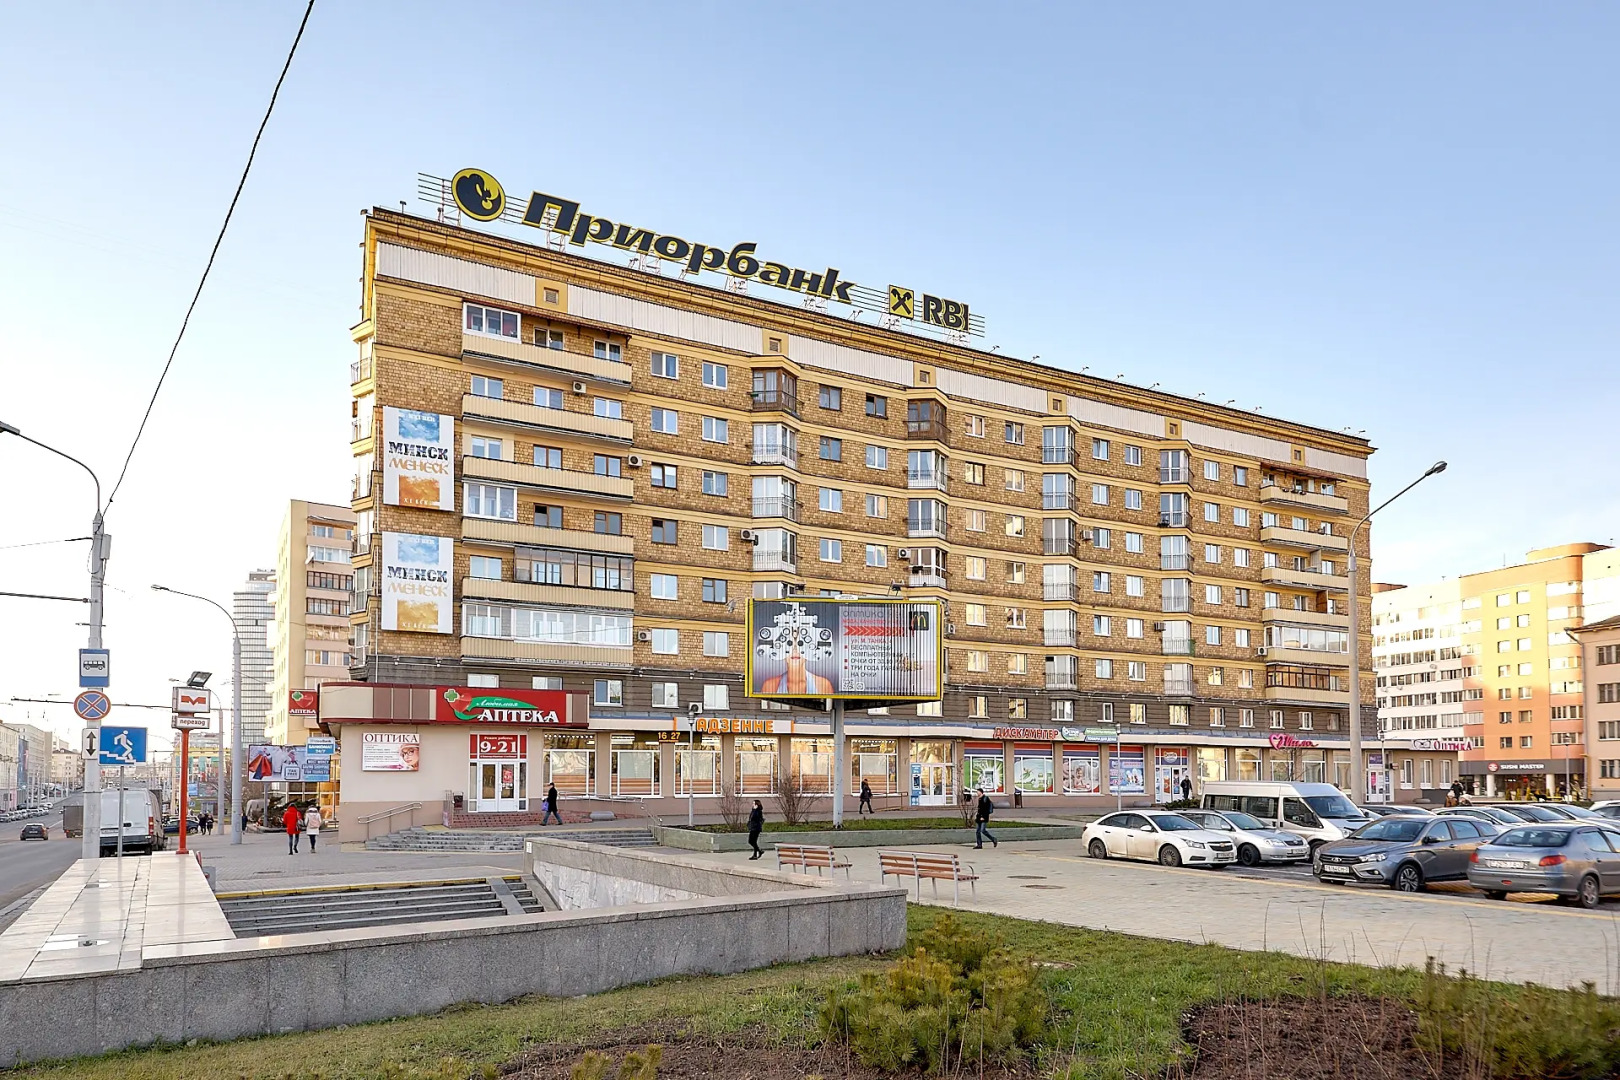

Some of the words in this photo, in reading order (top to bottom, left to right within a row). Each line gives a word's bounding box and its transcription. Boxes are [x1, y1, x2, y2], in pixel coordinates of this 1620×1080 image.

[522, 190, 856, 305] Приорбанк
[921, 293, 971, 332] RBI
[388, 440, 448, 461] МИНСК
[387, 565, 448, 583] МИНСК
[477, 708, 560, 723] АПТЕКА
[696, 718, 774, 735] АДЗЕННЕ
[992, 726, 1059, 740] ДИСКАУНТЕР
[364, 733, 418, 743] ОПТИКА
[657, 731, 667, 740] 16
[670, 731, 681, 740] 27
[480, 740, 517, 753] 9-21
